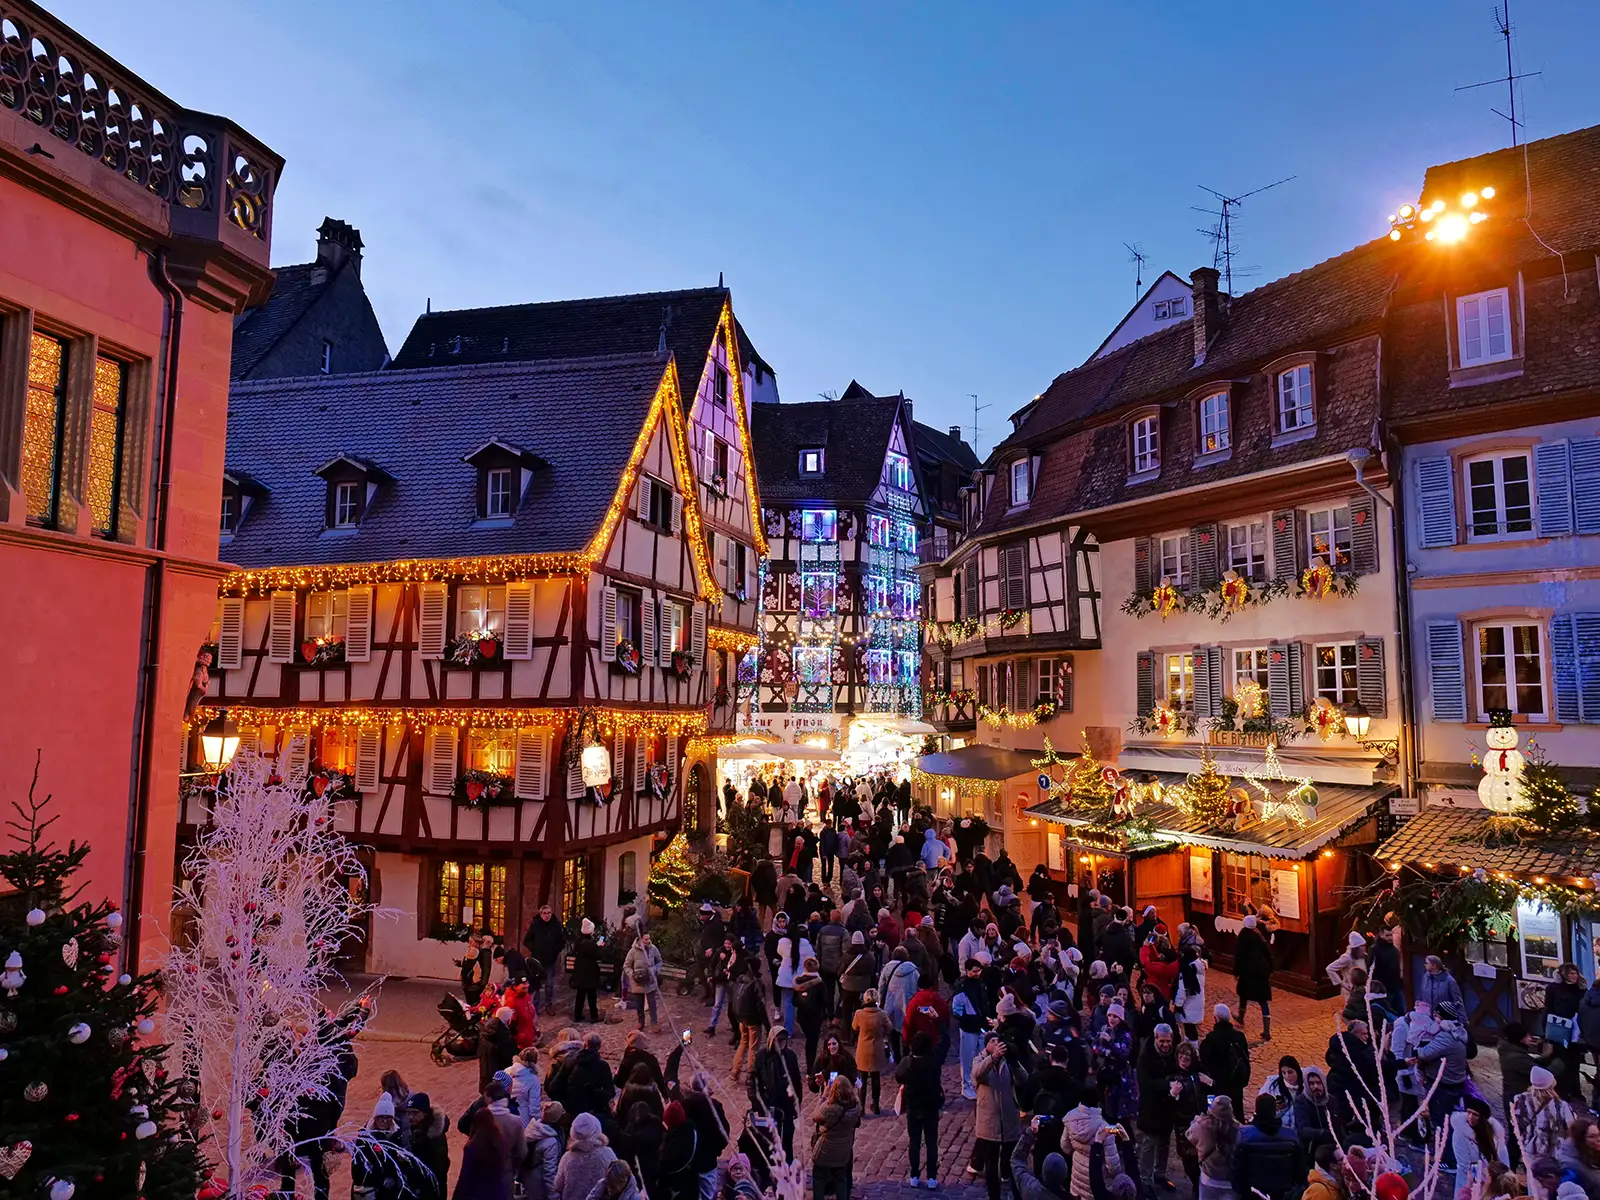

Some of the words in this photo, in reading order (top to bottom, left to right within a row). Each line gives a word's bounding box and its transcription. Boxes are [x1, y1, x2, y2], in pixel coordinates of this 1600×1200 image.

[1215, 732, 1227, 745] LE
[1107, 771, 1114, 781] 5
[1040, 777, 1046, 787] 7
[1305, 791, 1311, 803] 1
